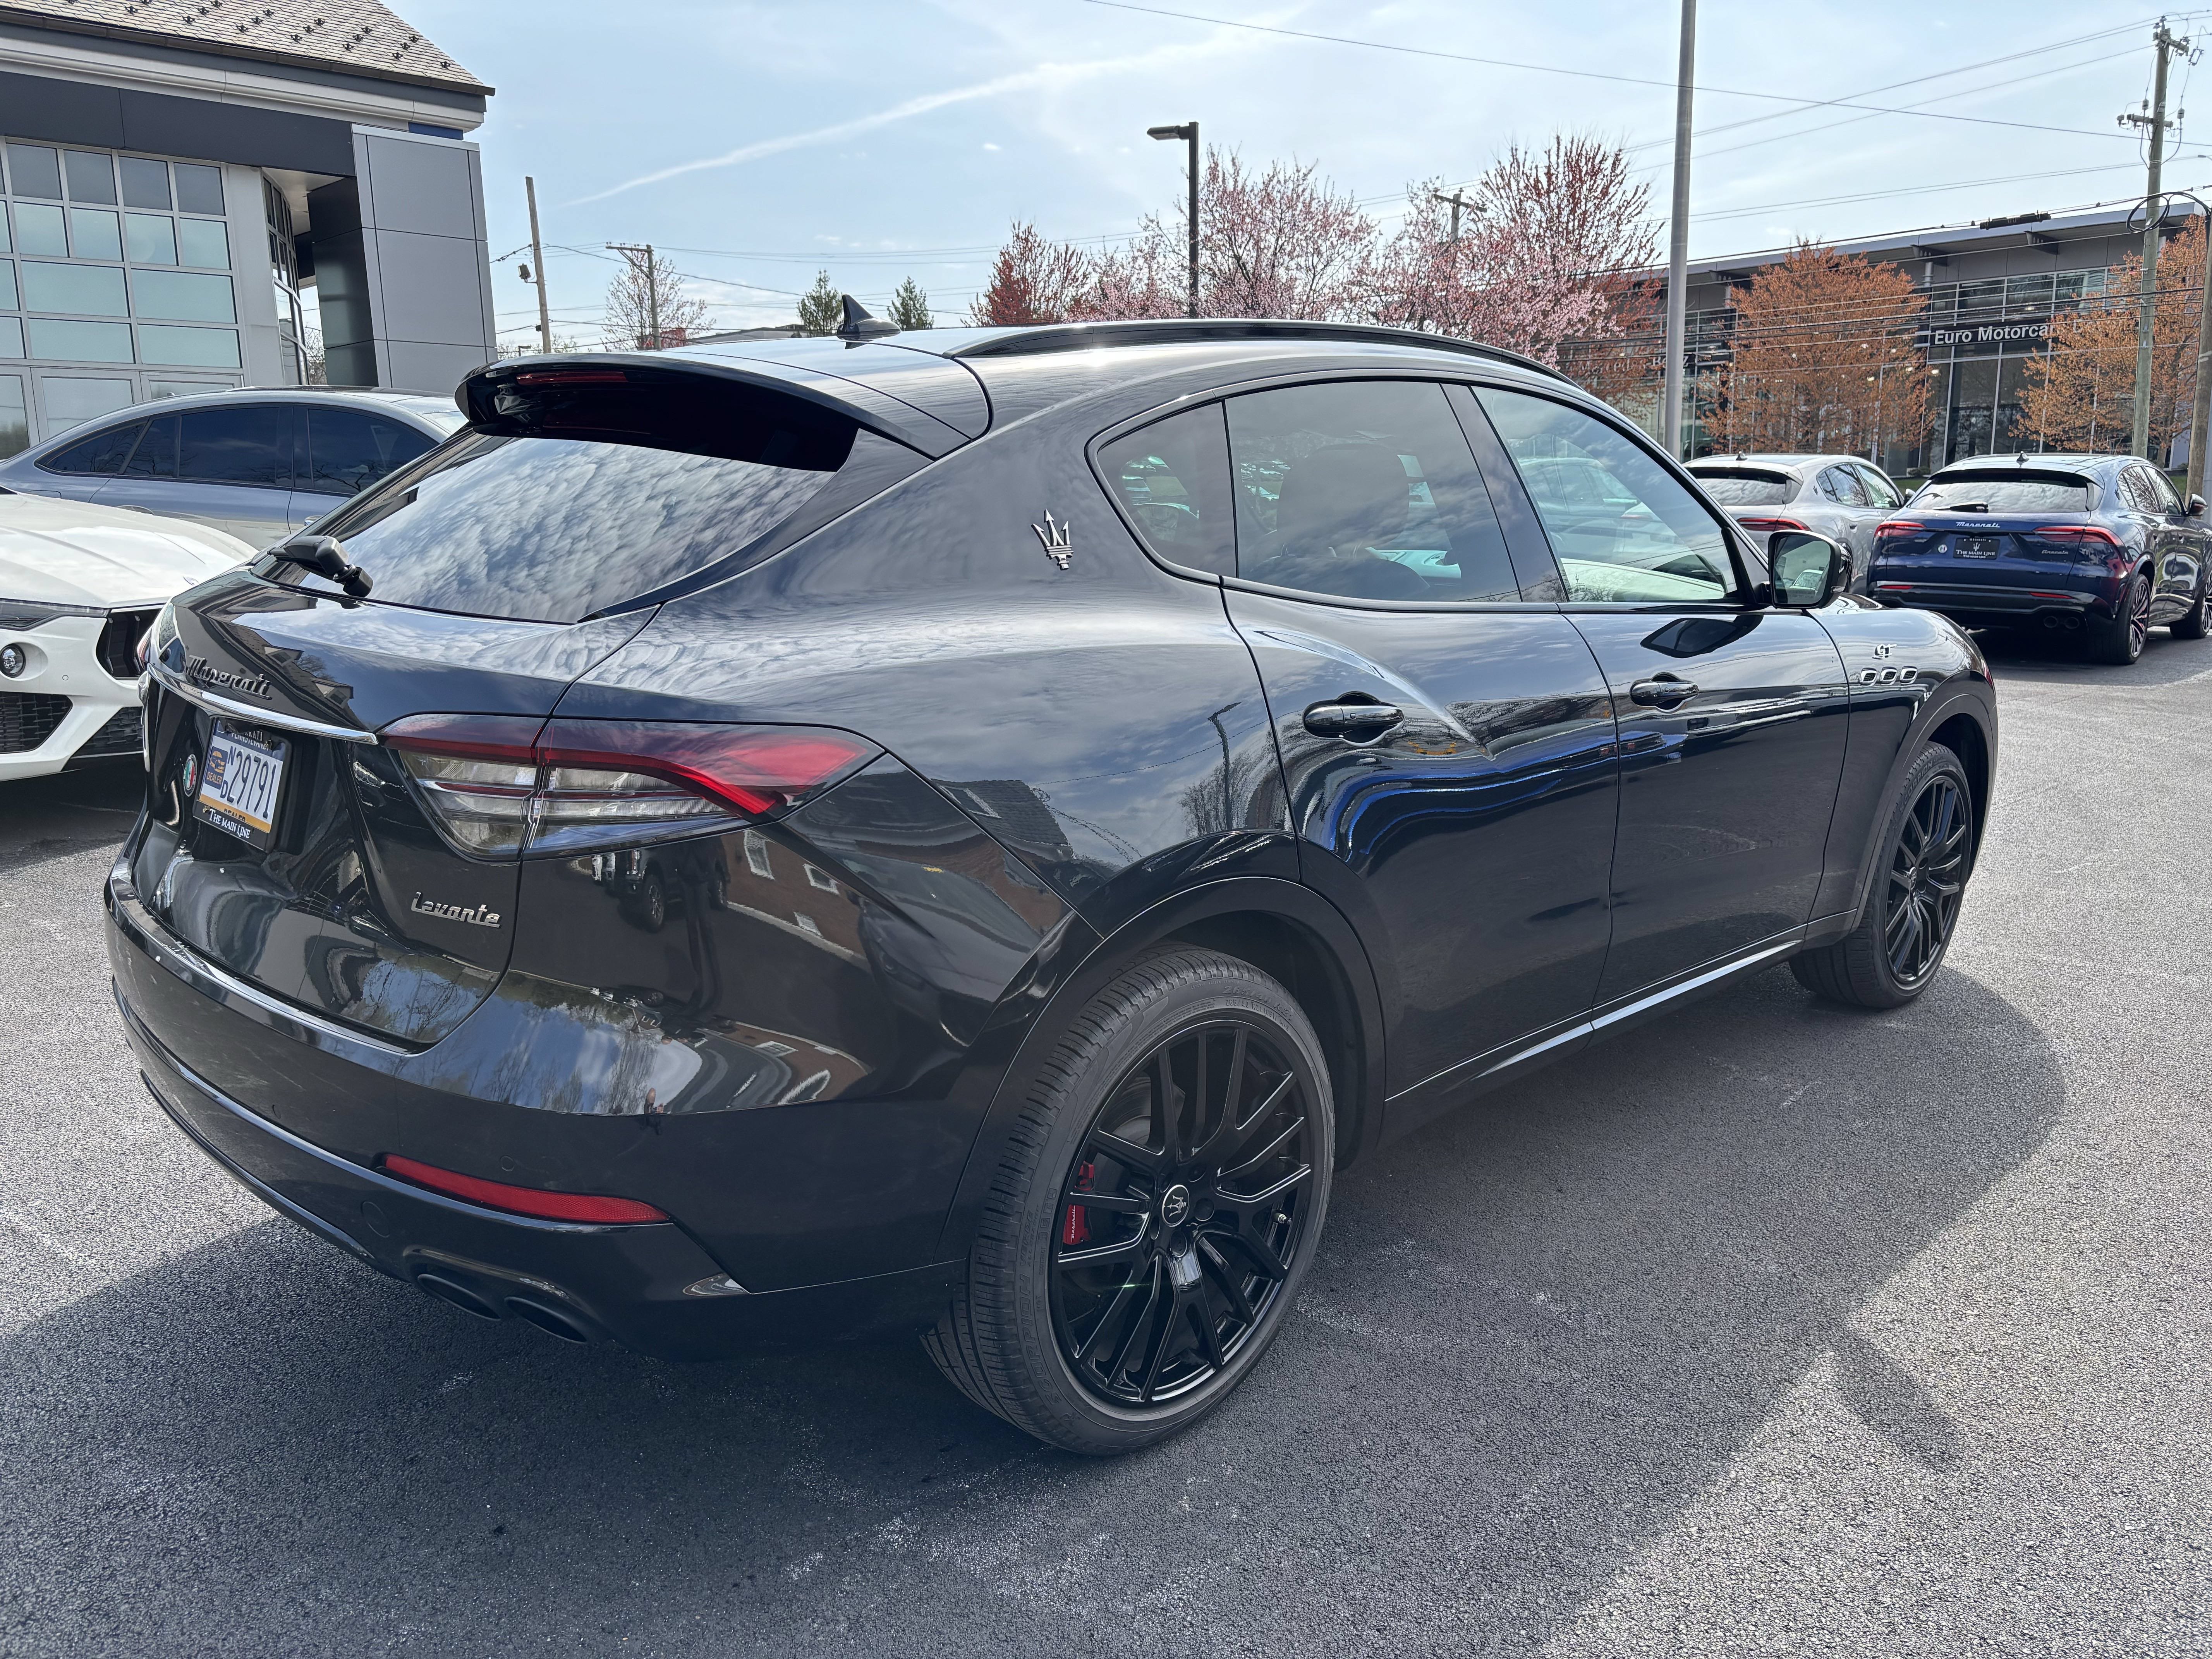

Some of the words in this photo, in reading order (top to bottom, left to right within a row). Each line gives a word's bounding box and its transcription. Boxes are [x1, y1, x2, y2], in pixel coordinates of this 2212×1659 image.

[1934, 330, 1972, 345] Euro
[1978, 324, 2065, 342] Motorcar
[1874, 644, 1897, 659] GT
[186, 654, 273, 701] Maserati
[206, 771, 222, 785] DEALER
[209, 808, 222, 825] THE
[221, 818, 236, 832] MAIN
[236, 823, 251, 839] LINE
[411, 891, 500, 928] Levante
[1020, 1209, 1033, 1266] VERDE
[1019, 1273, 1063, 1405] SCORPION
